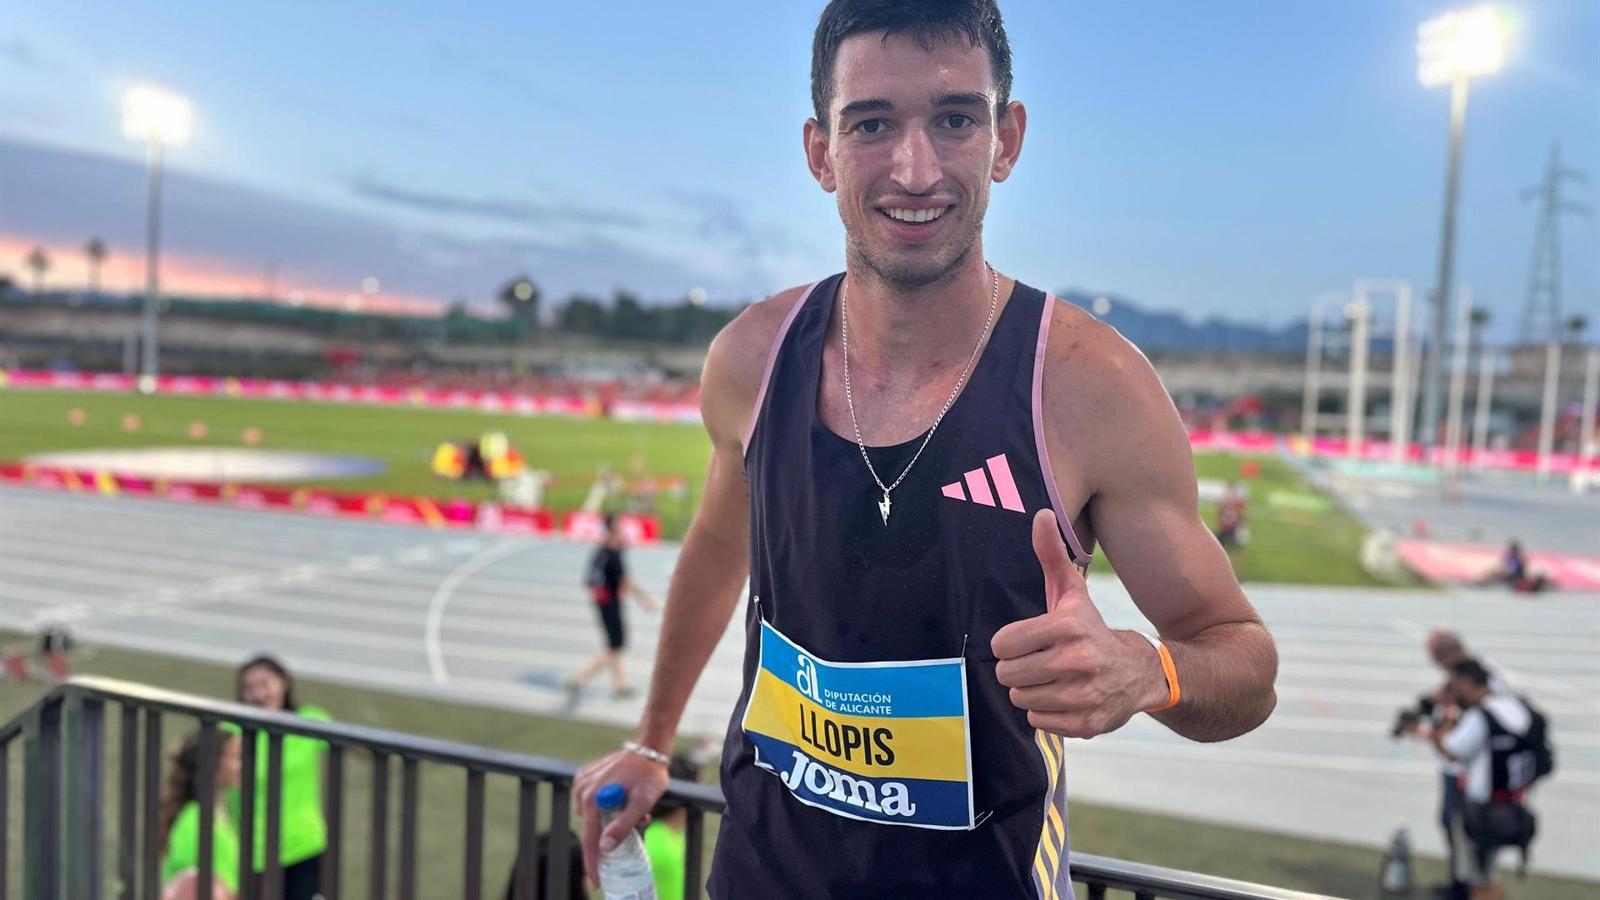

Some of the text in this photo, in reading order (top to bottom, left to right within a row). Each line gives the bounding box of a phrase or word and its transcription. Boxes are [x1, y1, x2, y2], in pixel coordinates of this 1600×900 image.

[824, 688, 892, 703] DIPUTACIÓN
[825, 700, 892, 714] DE ALICANTE
[800, 703, 895, 766] LLOPIS
